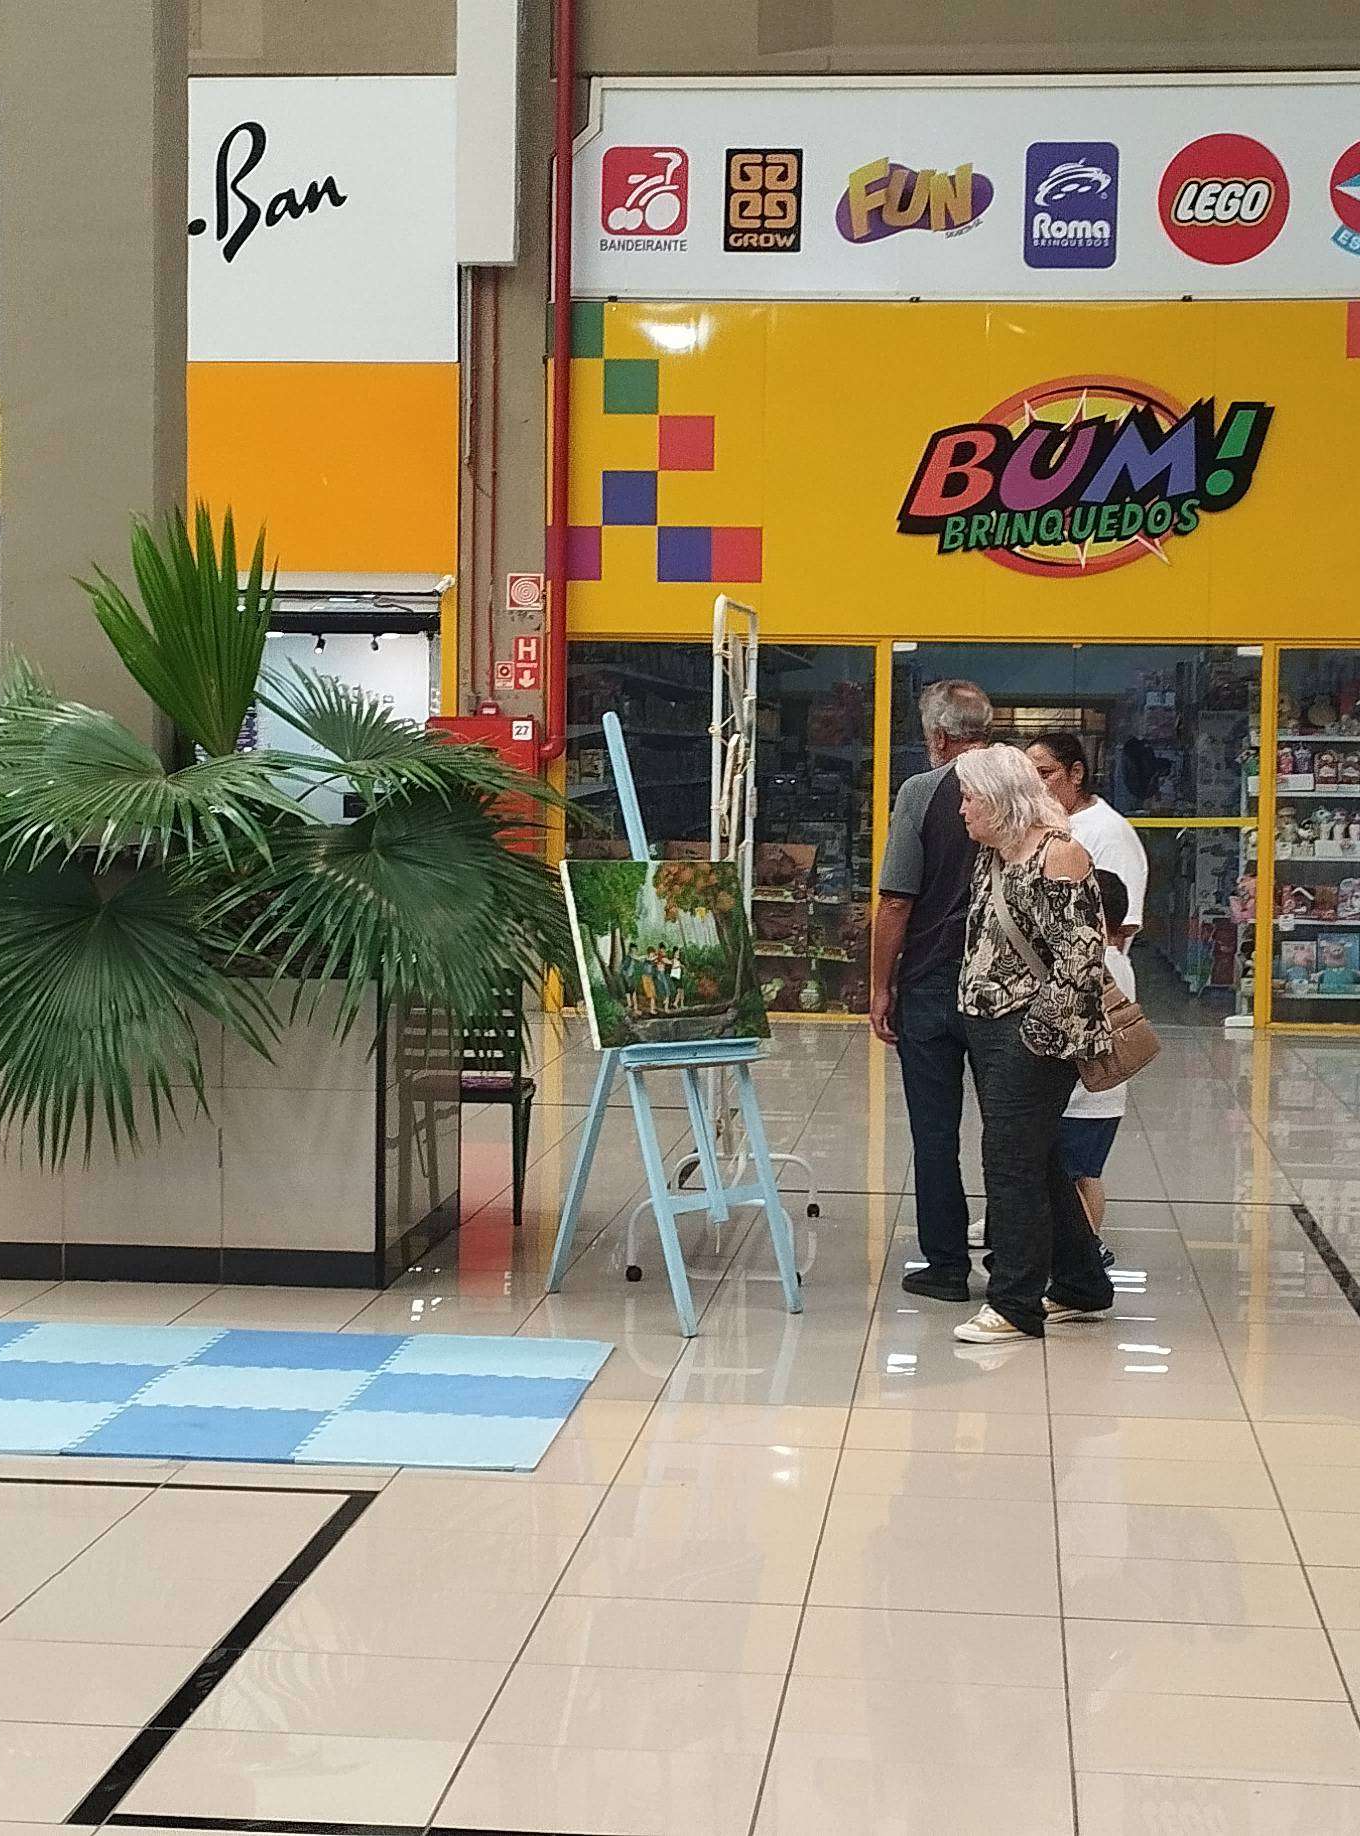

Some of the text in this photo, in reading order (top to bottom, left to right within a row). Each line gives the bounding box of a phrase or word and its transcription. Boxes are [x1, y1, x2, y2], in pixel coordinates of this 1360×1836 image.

[848, 157, 973, 240] FUN
[1175, 181, 1272, 222] LEGO
[729, 232, 796, 248] GROW
[1033, 212, 1111, 239] Roma
[600, 238, 688, 252] BANDEIRANTE
[904, 405, 1262, 518] BUM!
[941, 497, 1202, 554] BRINQUEDOS
[514, 725, 530, 737] 27
